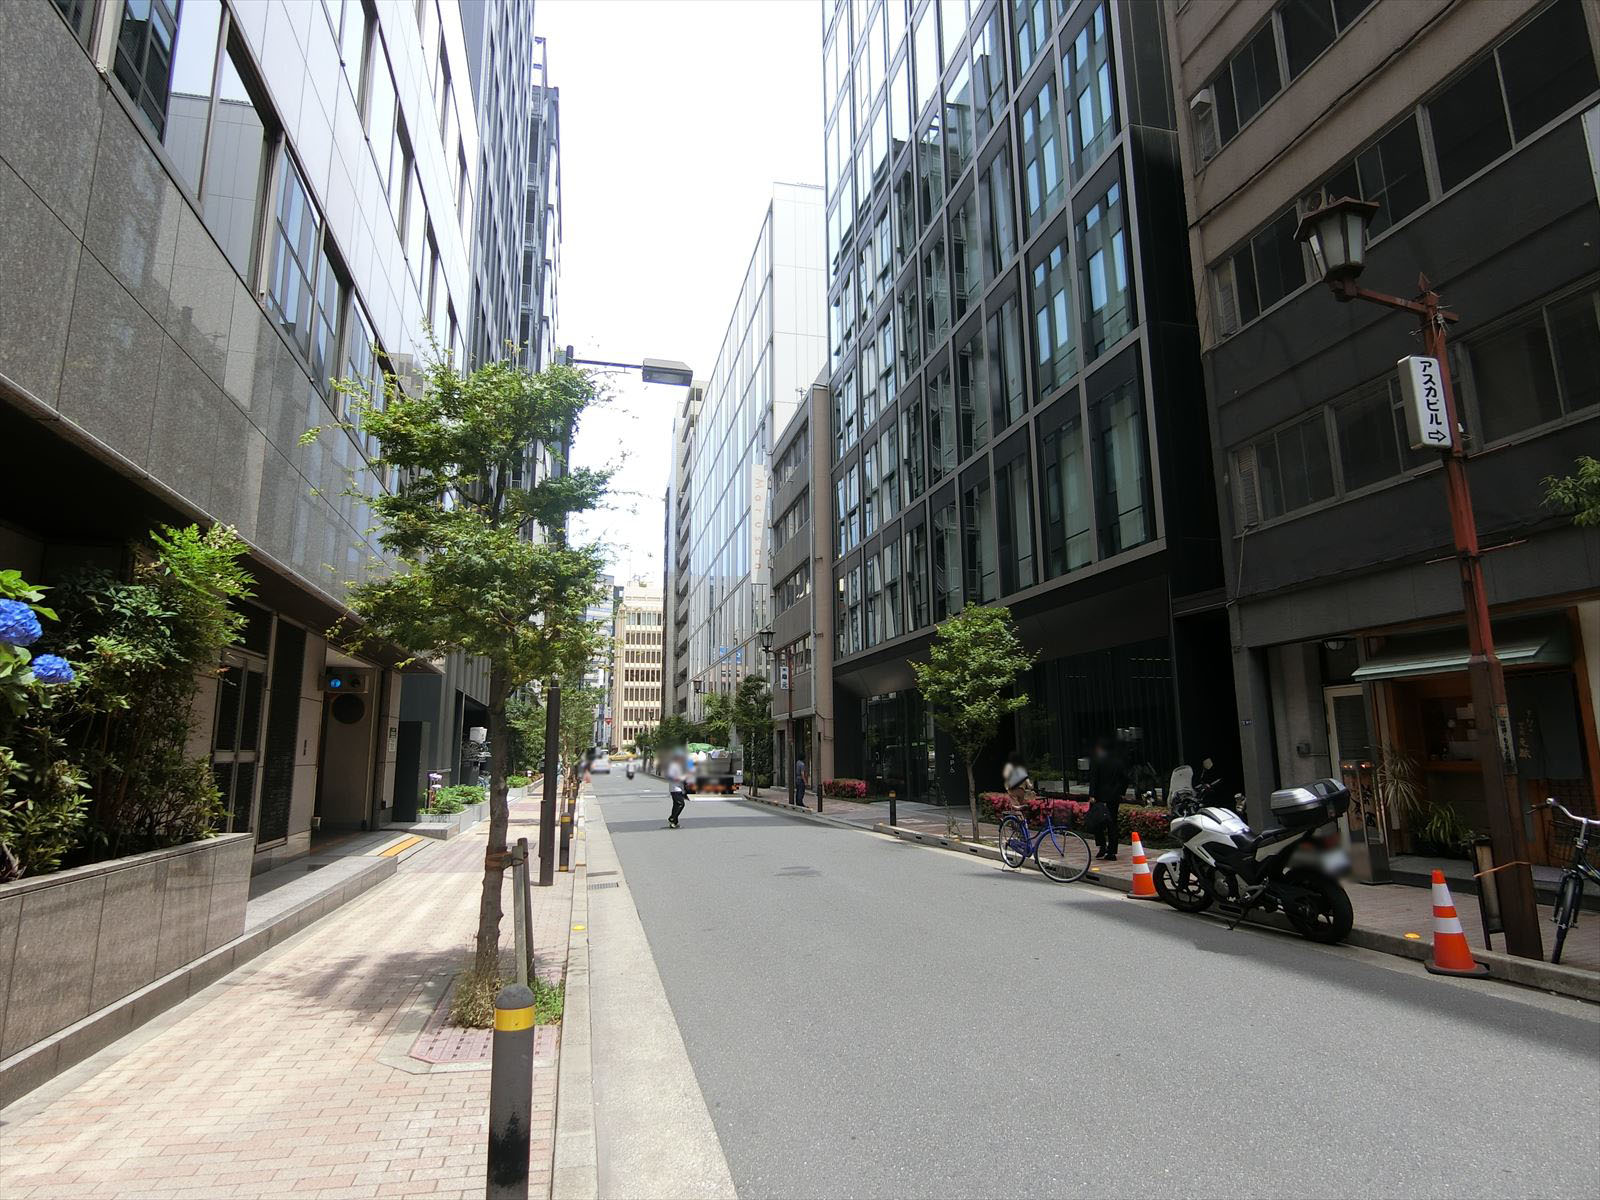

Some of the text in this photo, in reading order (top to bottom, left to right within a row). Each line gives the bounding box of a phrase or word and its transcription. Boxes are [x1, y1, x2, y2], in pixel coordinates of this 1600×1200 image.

[1420, 360, 1442, 425] アスカビル
